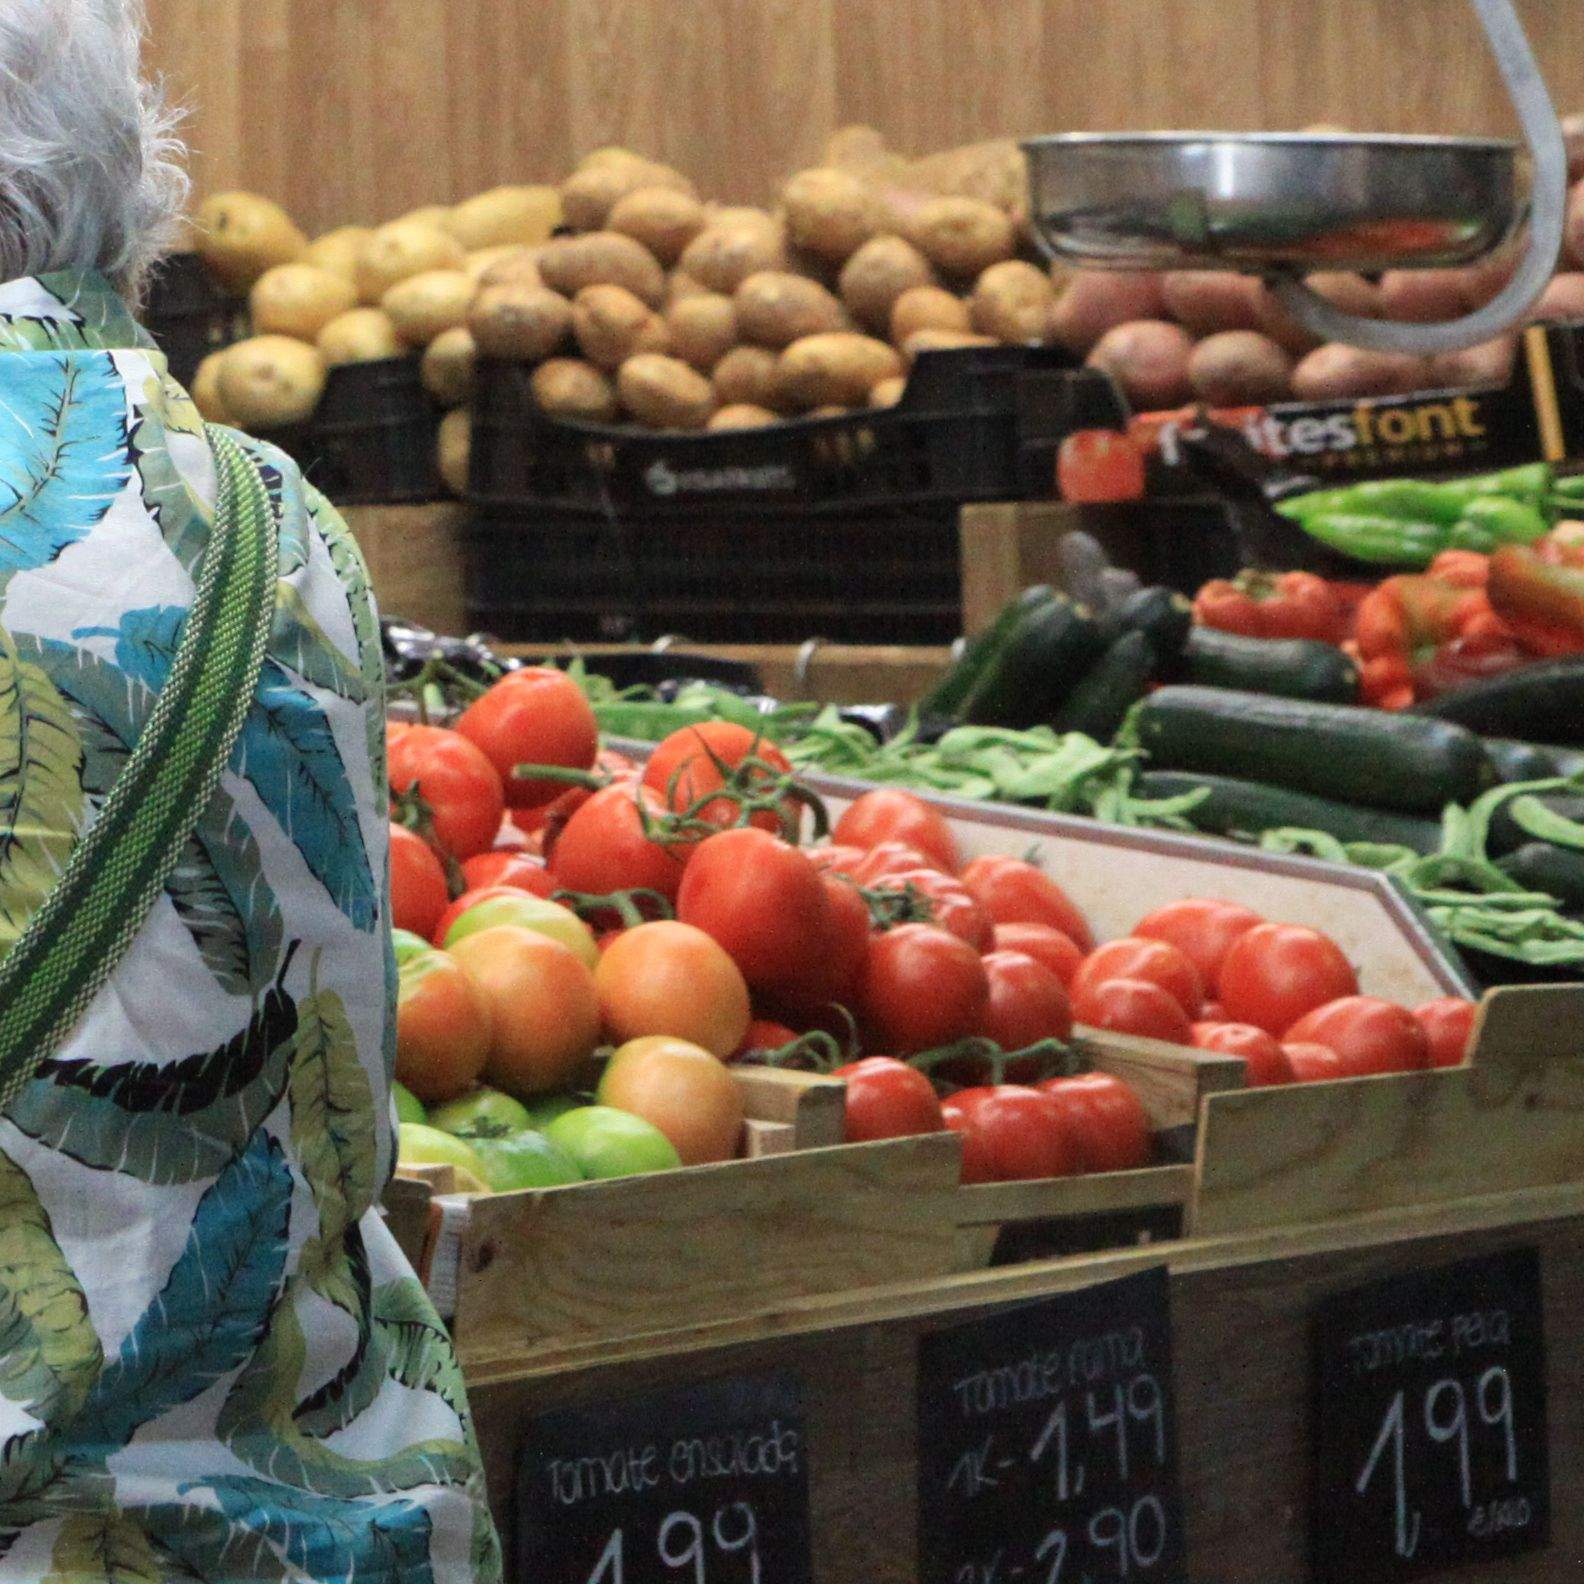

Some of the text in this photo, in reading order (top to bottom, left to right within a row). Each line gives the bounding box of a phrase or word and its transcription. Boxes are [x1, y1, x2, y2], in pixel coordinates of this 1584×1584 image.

[546, 1445, 661, 1506] Tomate
[1029, 1372, 1165, 1502] 1,49
[1354, 1363, 1518, 1559] 1,99
